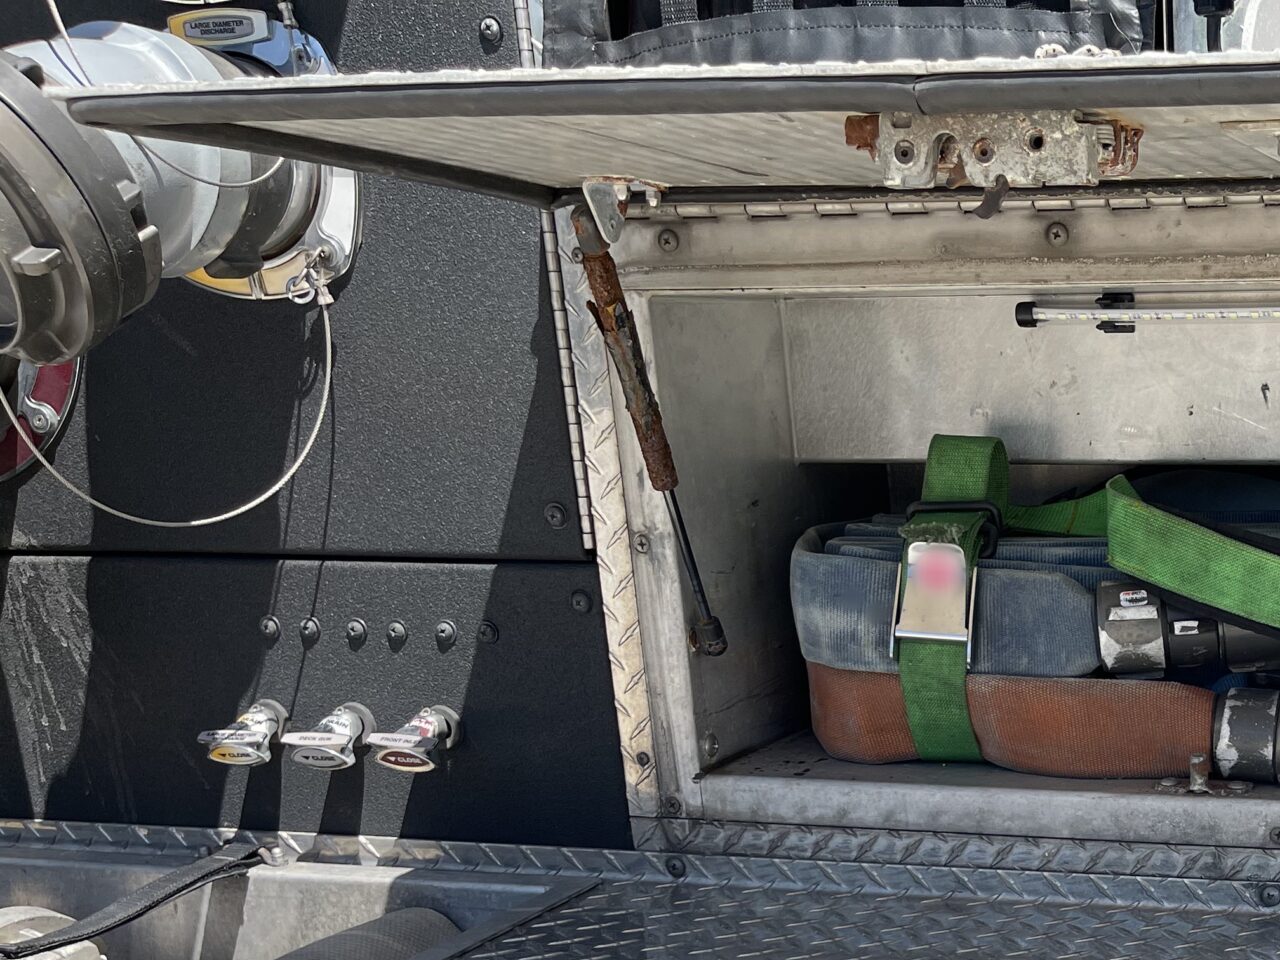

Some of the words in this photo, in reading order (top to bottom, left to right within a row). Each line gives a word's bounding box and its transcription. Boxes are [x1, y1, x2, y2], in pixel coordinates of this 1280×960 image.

[189, 21, 211, 29] LARGE
[212, 19, 244, 27] DIAMETER
[200, 27, 236, 35] DISCHARGE
[397, 756, 422, 764] CLOSE
